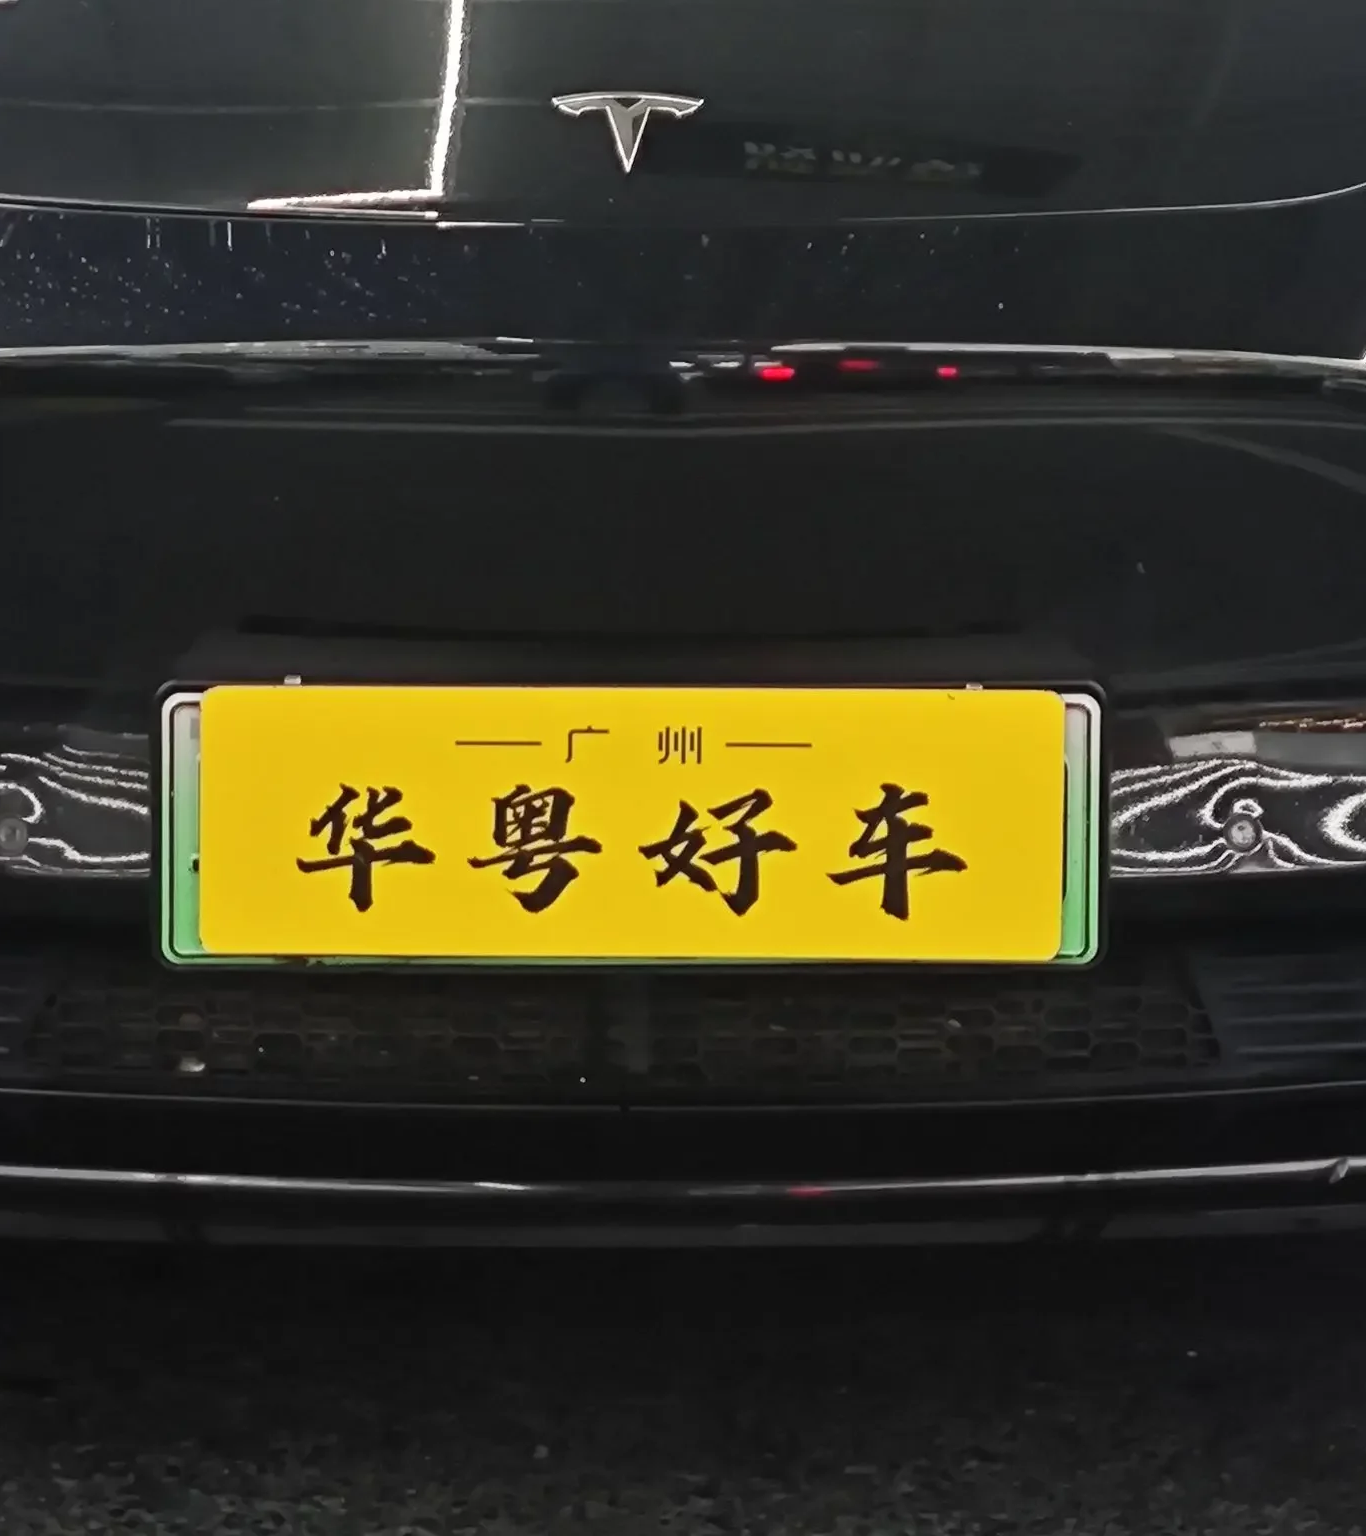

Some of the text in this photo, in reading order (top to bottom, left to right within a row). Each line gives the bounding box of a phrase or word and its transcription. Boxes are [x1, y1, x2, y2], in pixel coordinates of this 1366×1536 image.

[566, 726, 702, 764] 广州
[296, 783, 968, 921] 华粤好车
